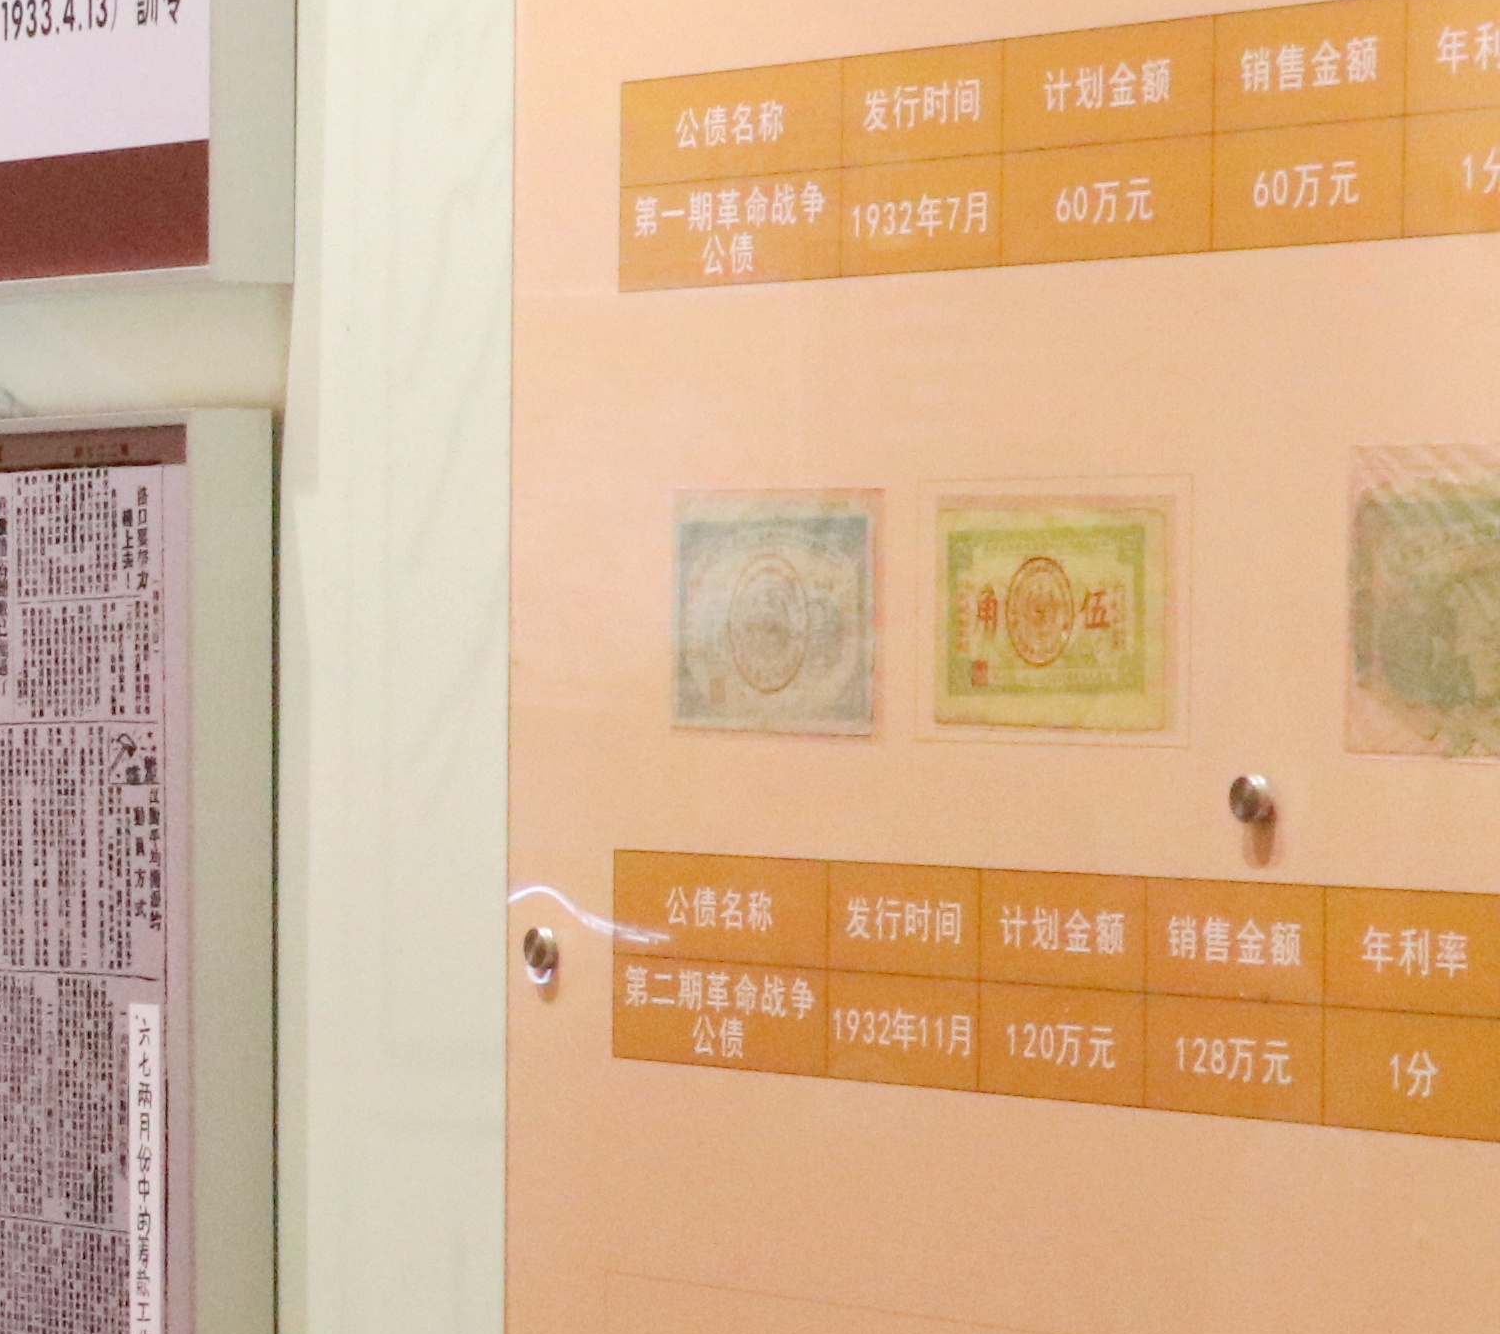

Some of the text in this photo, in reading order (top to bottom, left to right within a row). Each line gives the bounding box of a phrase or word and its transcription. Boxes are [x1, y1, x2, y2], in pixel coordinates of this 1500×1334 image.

[1044, 60, 1171, 114] 计划金额
[1240, 37, 1378, 93] 销售金额
[676, 99, 784, 149] 公债名称
[863, 80, 981, 132] 发行时间
[1055, 177, 1154, 225] 60万元
[1252, 160, 1359, 209] 60万元
[634, 186, 826, 238] 第一期革命战争
[852, 190, 990, 240] 1932年7月
[702, 233, 754, 276] 公债
[666, 886, 773, 931] 公债名称
[845, 897, 963, 945] 发行时间
[1000, 906, 1125, 957] 计划金额
[1168, 915, 1302, 967] 销售金额
[1361, 926, 1469, 978] 年利率
[625, 966, 815, 1021] 第二期革命战争
[692, 1015, 745, 1060] 公债
[834, 1007, 973, 1056] 1932年11月
[1006, 1022, 1116, 1070] 120万元
[1176, 1035, 1292, 1086] 128万元
[1391, 1050, 1438, 1097] 1分
